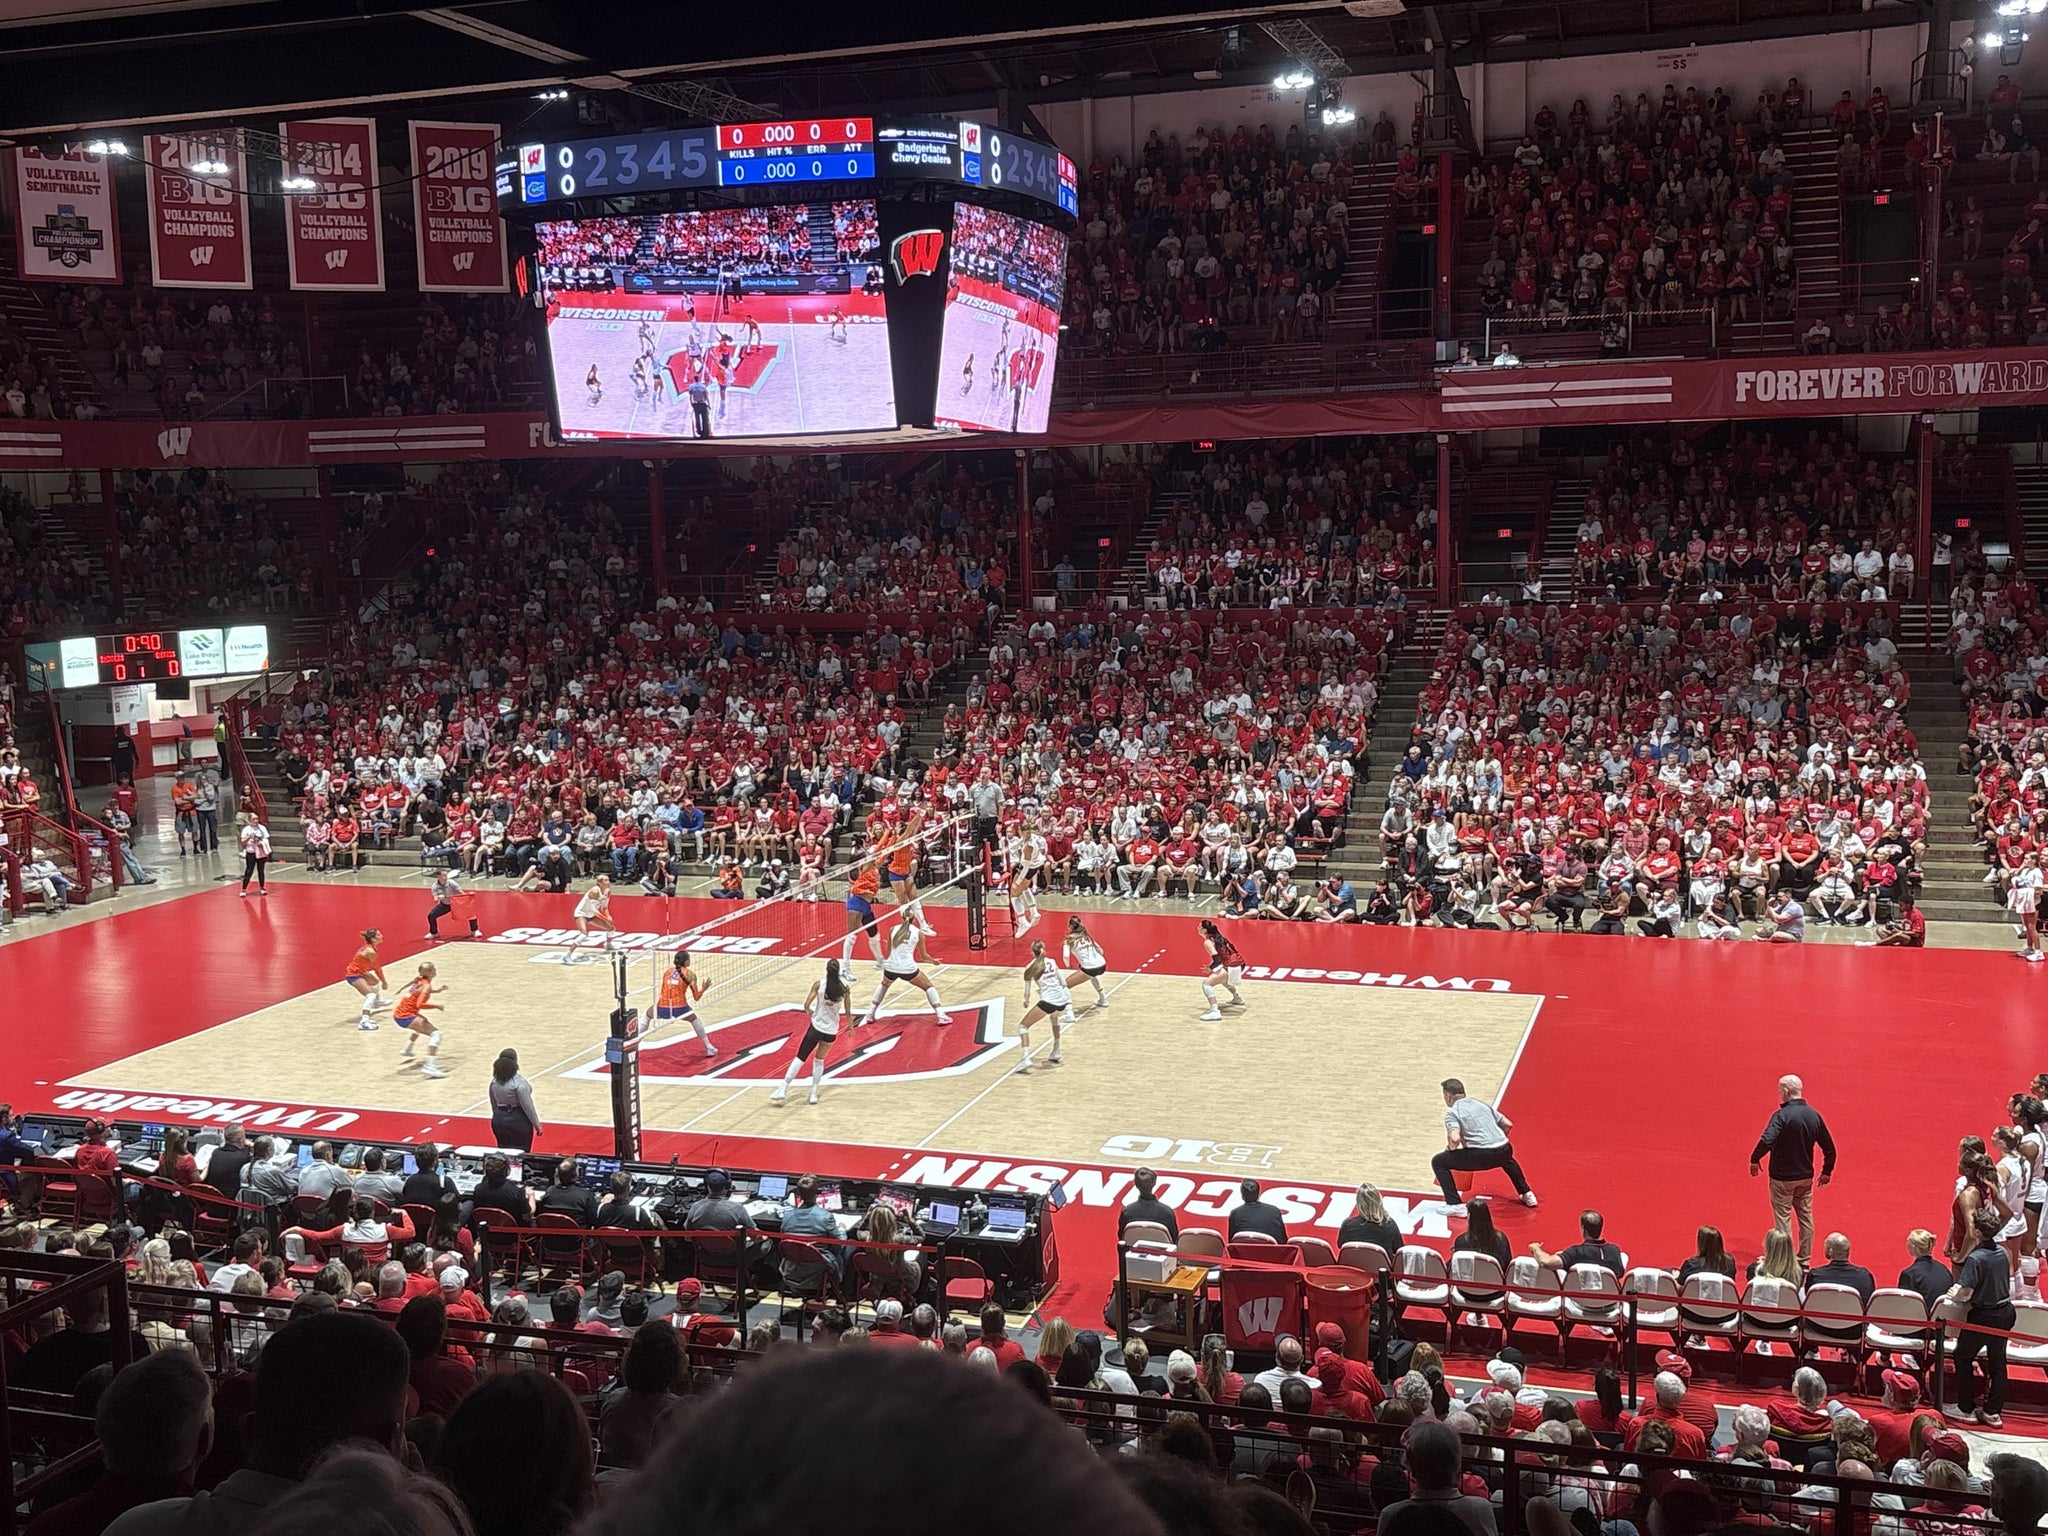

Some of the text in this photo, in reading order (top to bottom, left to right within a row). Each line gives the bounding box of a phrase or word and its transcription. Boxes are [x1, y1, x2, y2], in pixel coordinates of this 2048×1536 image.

[732, 121, 857, 145] 0 .000 0 0
[906, 129, 958, 141] CHEVROLET
[729, 142, 863, 159] KILLS HIT % ERR ATT
[897, 141, 948, 156] Badgerland
[990, 134, 1001, 157] 0
[296, 141, 363, 177] 2014
[425, 145, 488, 180] 2019
[558, 146, 574, 169] 0
[891, 151, 952, 165] Chevy Dealers
[25, 167, 101, 183] VOLLEYBALL
[734, 158, 859, 181] 0 .000 0 0
[991, 162, 1002, 185] 0
[26, 181, 102, 195] SEMIFINALIST
[560, 173, 575, 196] 0
[163, 208, 234, 225] VOLLEYBALL
[299, 214, 367, 228] VOLLEYBALL
[429, 216, 493, 231] VOLLEYBALL
[164, 222, 235, 239] CHAMPIONS
[300, 226, 368, 241] CHAMPIONS
[429, 230, 494, 244] CHAMPIONS
[189, 245, 214, 267] W
[324, 249, 348, 270] W
[452, 251, 475, 272] W
[558, 306, 666, 322] WISCONSIN
[1735, 359, 2048, 402] FOREVER FORWARD
[157, 427, 192, 461] W
[115, 664, 126, 681] 0
[140, 666, 146, 678] 1
[168, 660, 179, 676] 0
[52, 1090, 361, 1132] UWHealth
[890, 1152, 1454, 1240] WISCONSIN
[1237, 1296, 1285, 1338] W
